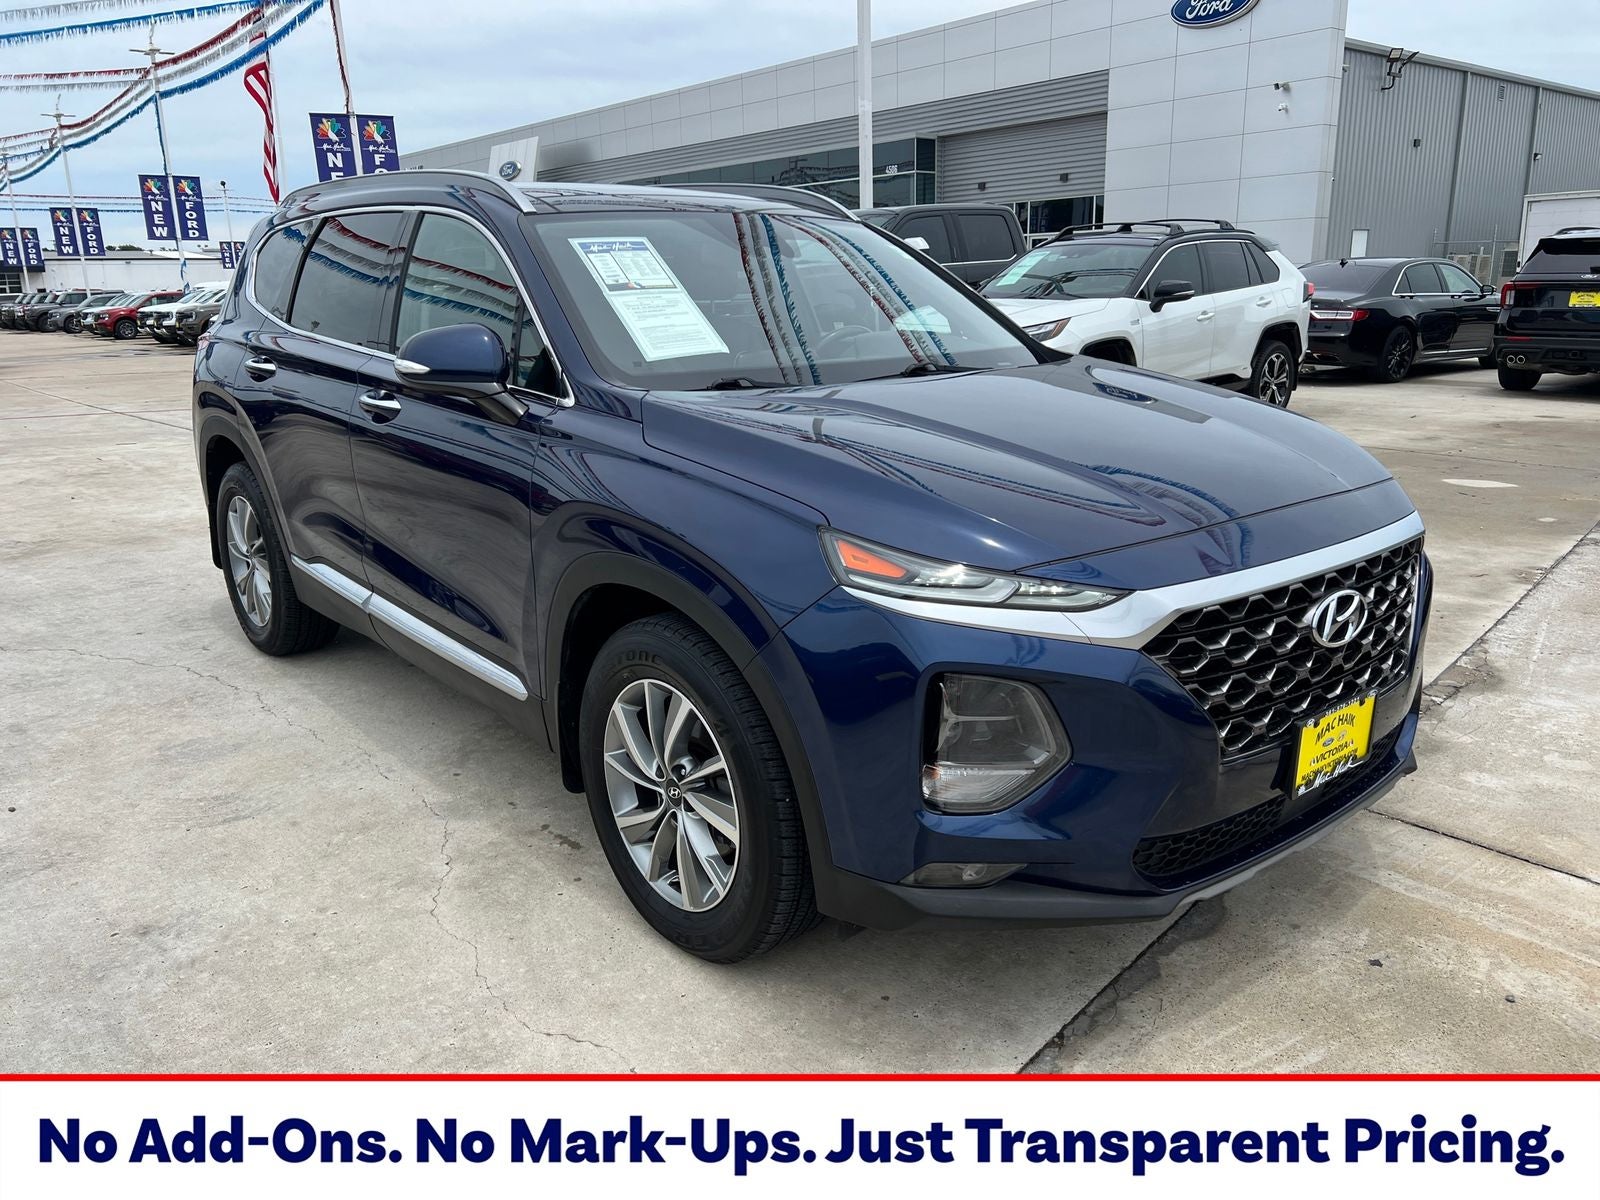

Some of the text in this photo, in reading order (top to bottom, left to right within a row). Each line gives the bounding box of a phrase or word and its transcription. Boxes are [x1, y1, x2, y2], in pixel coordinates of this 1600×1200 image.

[150, 201, 168, 237] NEW
[185, 201, 199, 238] FORD
[6, 242, 18, 265] NEW
[27, 242, 38, 265] FORD
[59, 226, 73, 254] NEW
[86, 226, 99, 254] FORD
[1315, 716, 1337, 745] MAC
[1337, 712, 1356, 727] HAIK
[1315, 740, 1350, 763] VICTORIA
